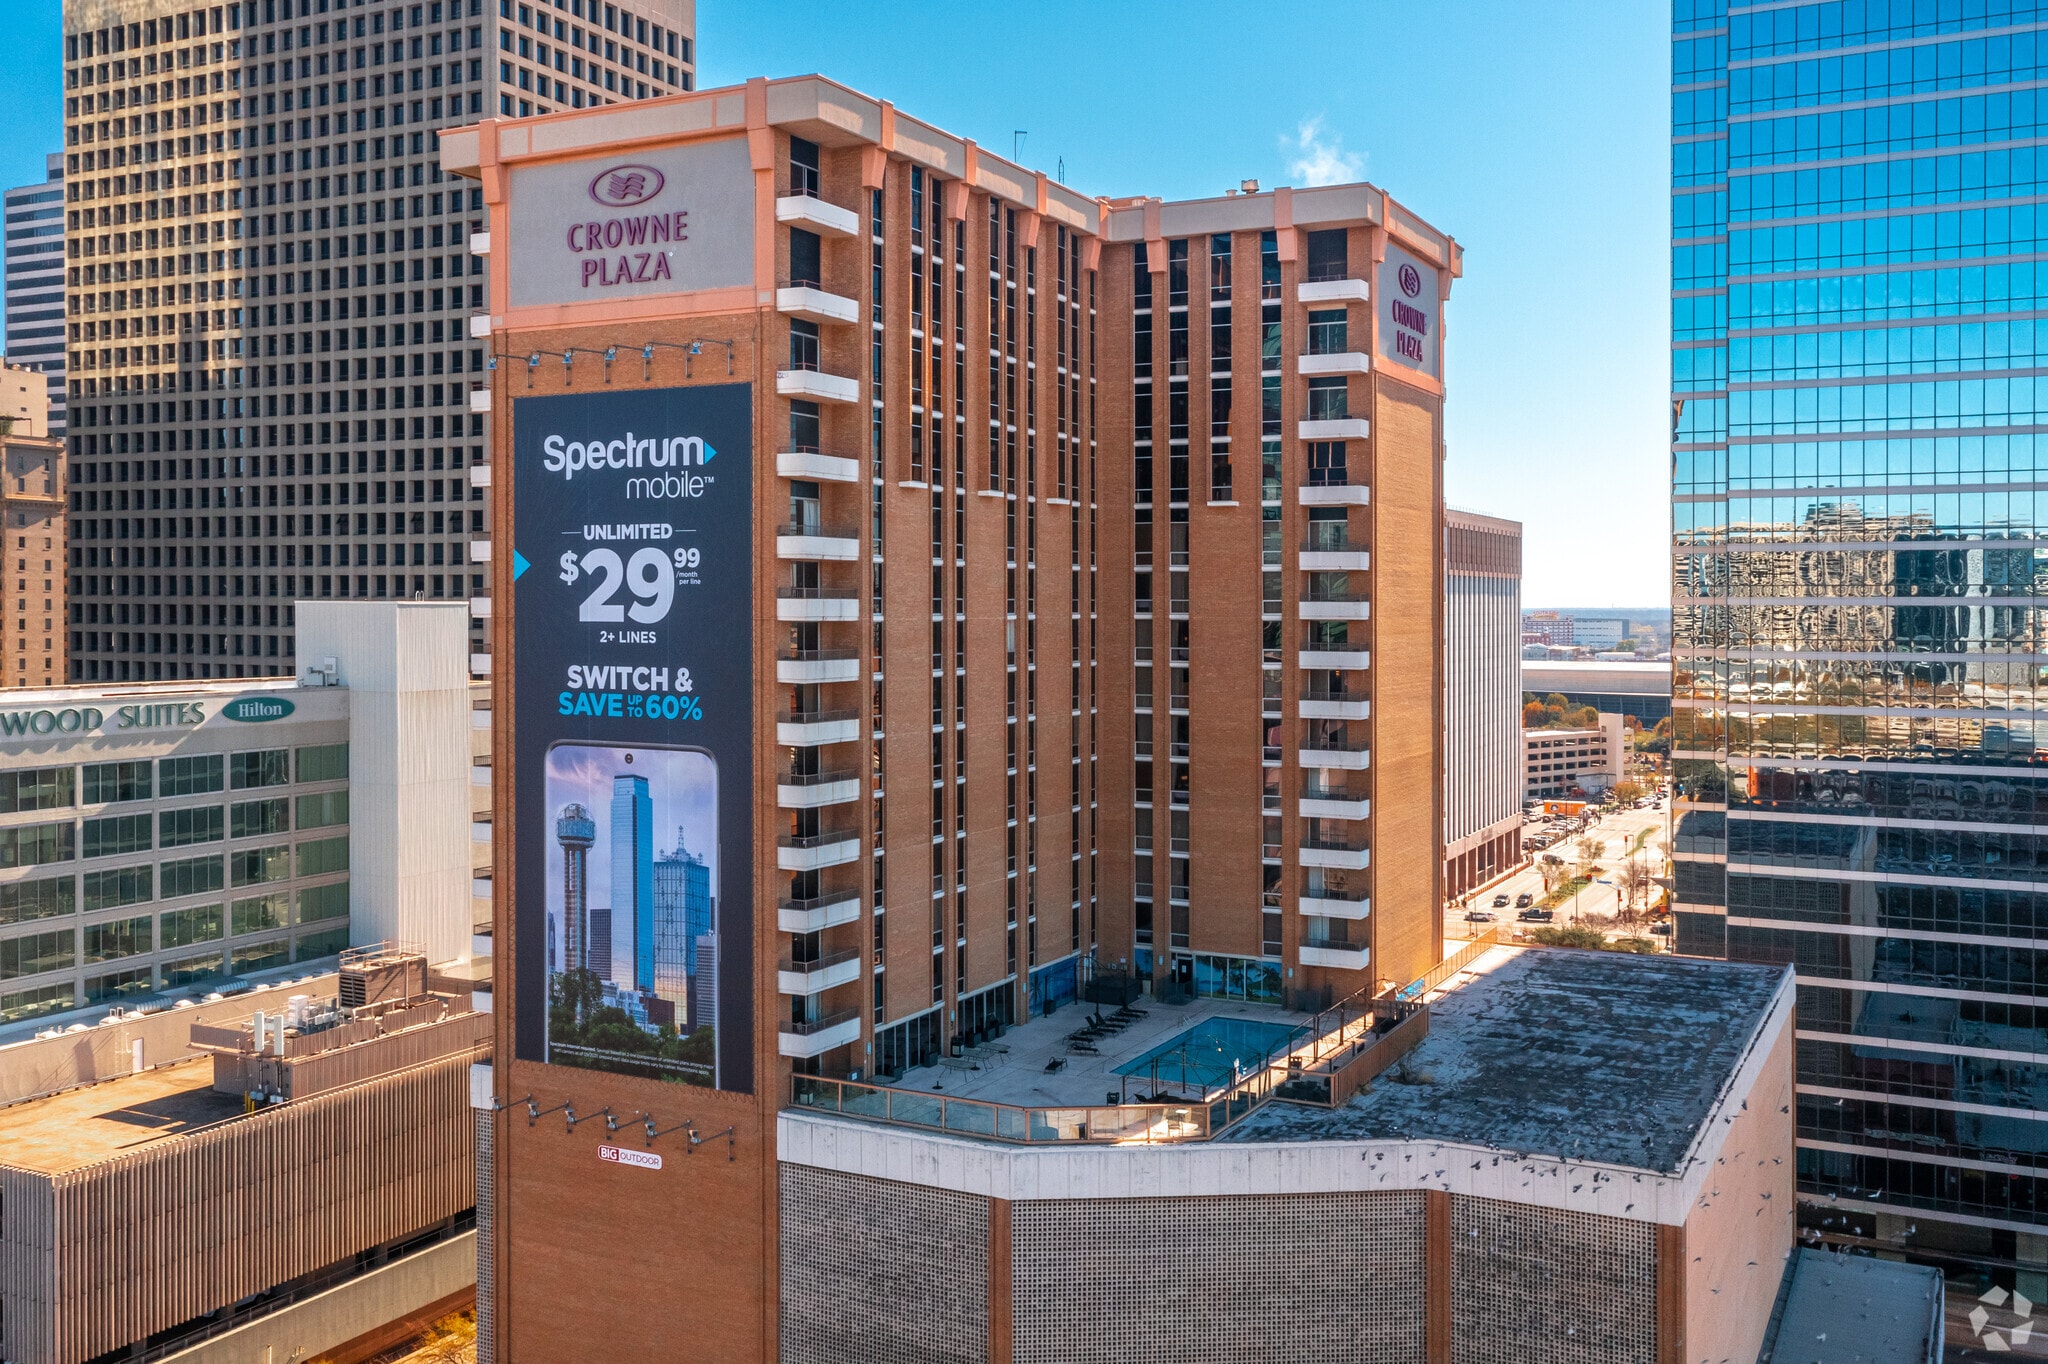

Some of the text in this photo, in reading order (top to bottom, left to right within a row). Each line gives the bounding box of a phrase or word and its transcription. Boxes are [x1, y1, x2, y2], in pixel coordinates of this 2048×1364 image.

[566, 211, 688, 252] CROWNE
[581, 252, 671, 287] PLAZA
[1392, 299, 1427, 335] CROWNE
[1396, 330, 1423, 362] PLAZA
[543, 432, 704, 480] Spectrum
[626, 471, 704, 499] mobile
[583, 523, 673, 540] UNLIMITED
[600, 630, 657, 644] 2+ LINES
[567, 664, 693, 692] SWITCH &
[118, 701, 206, 729] SUITES
[238, 702, 283, 718] Hilton
[558, 691, 703, 721] SAVE UP TO 60%
[601, 1147, 660, 1166] BIG OUTDOOR
